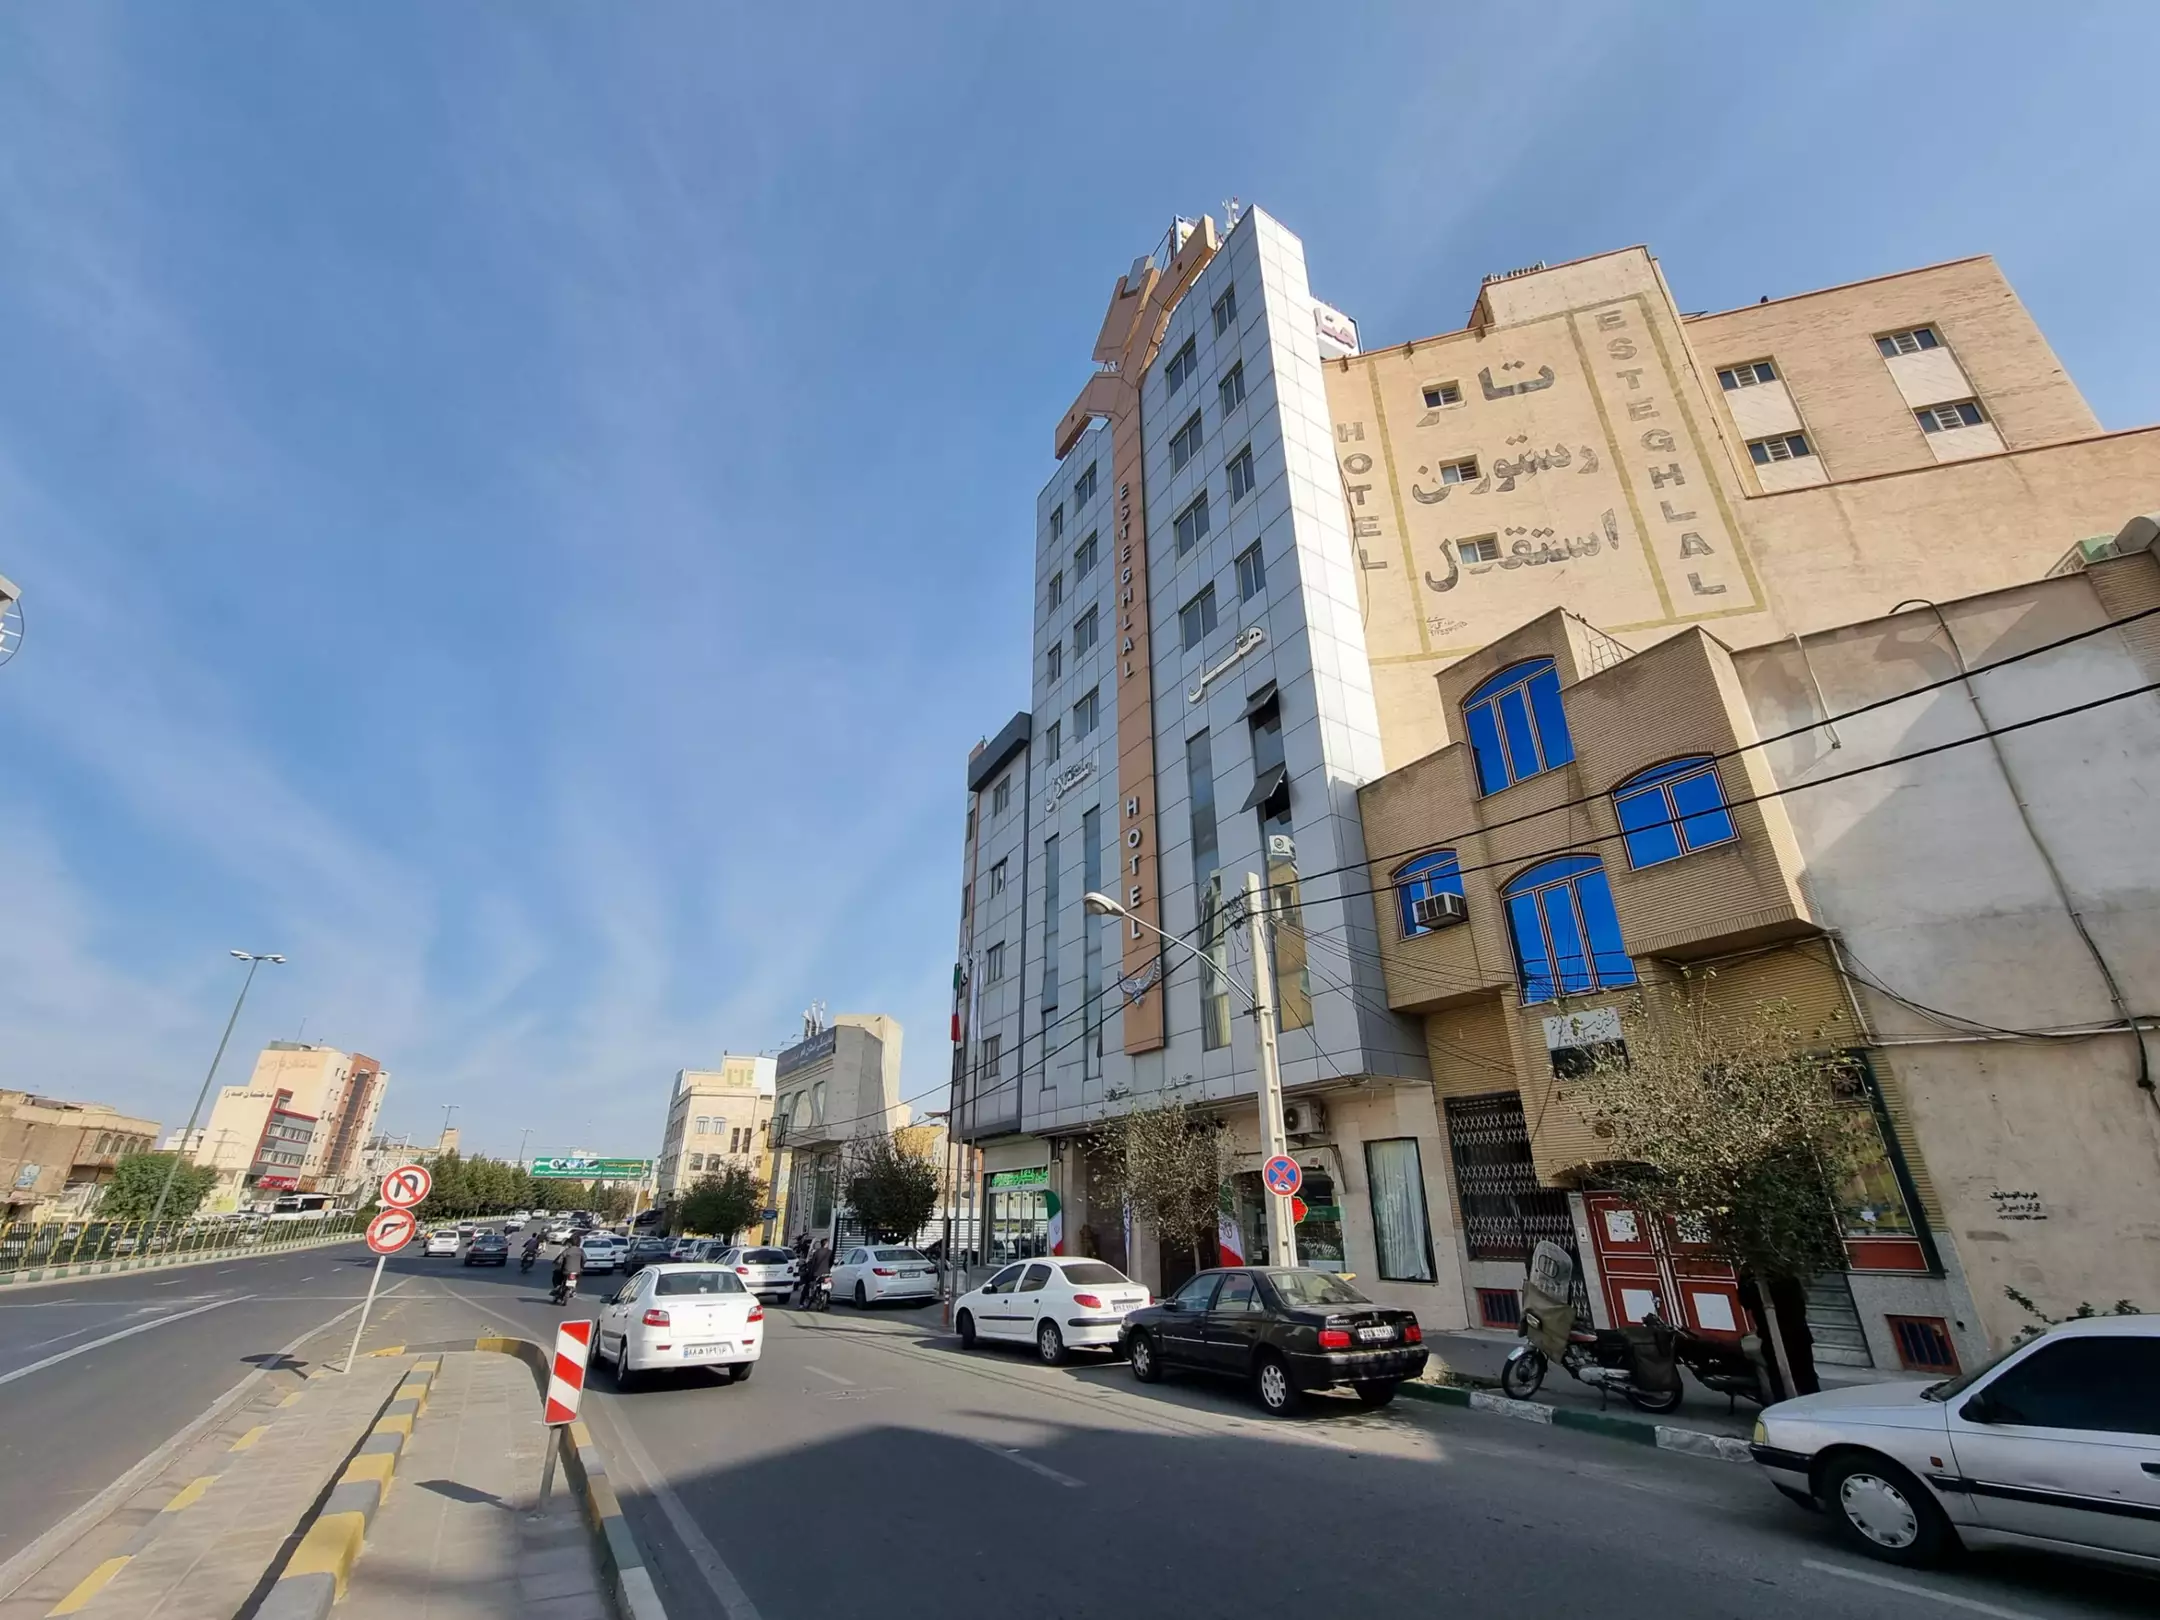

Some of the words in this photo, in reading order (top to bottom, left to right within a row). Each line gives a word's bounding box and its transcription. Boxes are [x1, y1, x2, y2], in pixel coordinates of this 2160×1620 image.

[1416, 360, 1555, 427] تار
[1336, 421, 1388, 570] HOTEL
[1412, 434, 1599, 504] رستورن
[1595, 310, 1727, 596] ESTEGHLAL
[1119, 482, 1136, 679] ESTEGHLAL
[1188, 626, 1263, 704] هتل
[1044, 748, 1099, 812] استقلال
[1126, 796, 1143, 941] HOTEL
